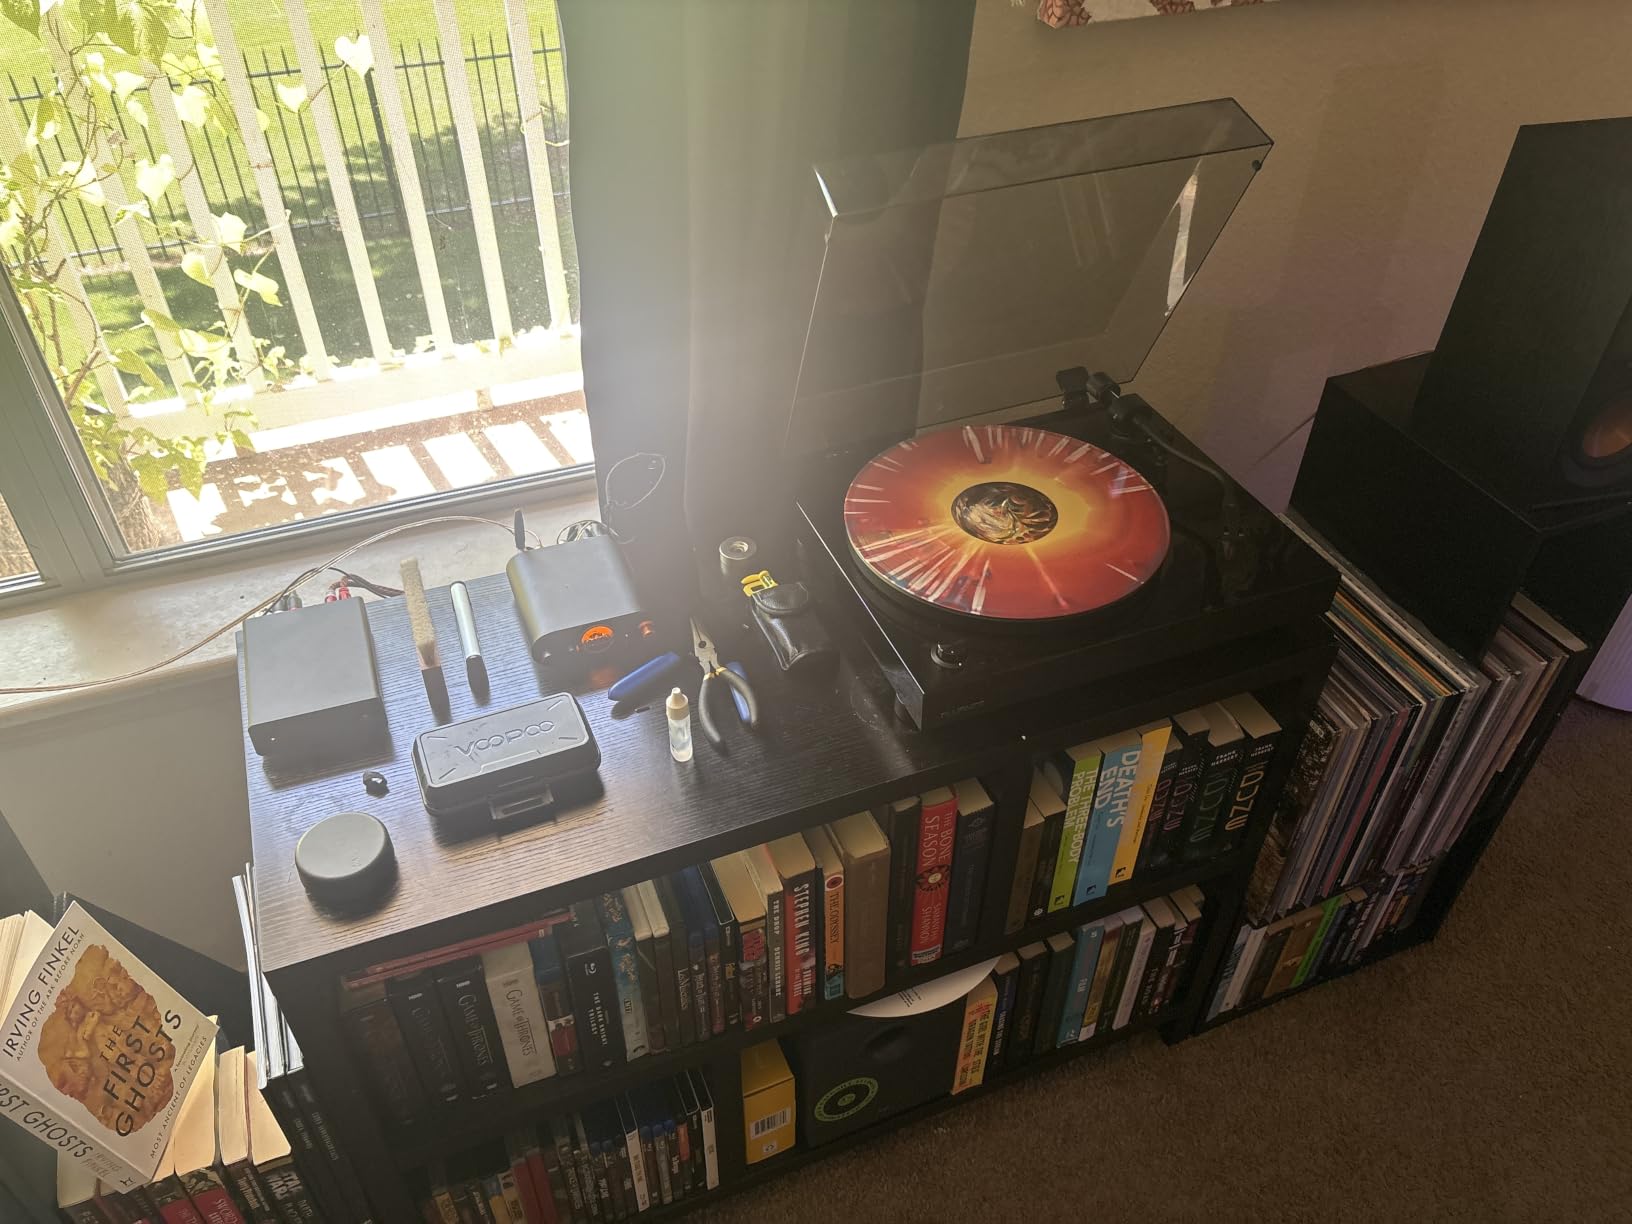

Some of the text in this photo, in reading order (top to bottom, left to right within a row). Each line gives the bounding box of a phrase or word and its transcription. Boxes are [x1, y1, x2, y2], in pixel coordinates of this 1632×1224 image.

[453, 720, 555, 757] VOOPOO
[1063, 771, 1086, 829] PROBLEM
[1083, 768, 1099, 794] THE
[1095, 766, 1120, 810] END
[1106, 750, 1141, 828] DEATH'S
[1223, 770, 1265, 832] DUNE
[921, 815, 941, 869] SEASON
[938, 811, 953, 862] THE BONE
[1069, 794, 1092, 864] THREE-BODY
[793, 883, 811, 956] STEPHEN KING
[829, 892, 841, 943] THE ODYSSEY
[918, 906, 933, 944] SHANNON
[2, 926, 80, 1058] IRVING FINKEL
[16, 933, 85, 1061] AUTHOR OF THE ARK BEFORE NOAH
[505, 989, 524, 1018] GAME
[99, 1024, 124, 1062] THE
[457, 993, 481, 1025] GAME
[470, 1024, 494, 1067] THRONES
[513, 1018, 538, 1057] THRONES
[587, 1008, 599, 1036] TRILOGY
[593, 992, 609, 1048] THE DARK KNIGHT
[103, 1015, 151, 1101] FIRST
[115, 1009, 183, 1137] GHOSTS
[150, 1131, 164, 1159] MOST
[162, 1091, 182, 1130] ANCIENT
[179, 1076, 188, 1089] OF
[187, 1036, 208, 1075] LEGACIES
[22, 1110, 94, 1158] GHOSTS
